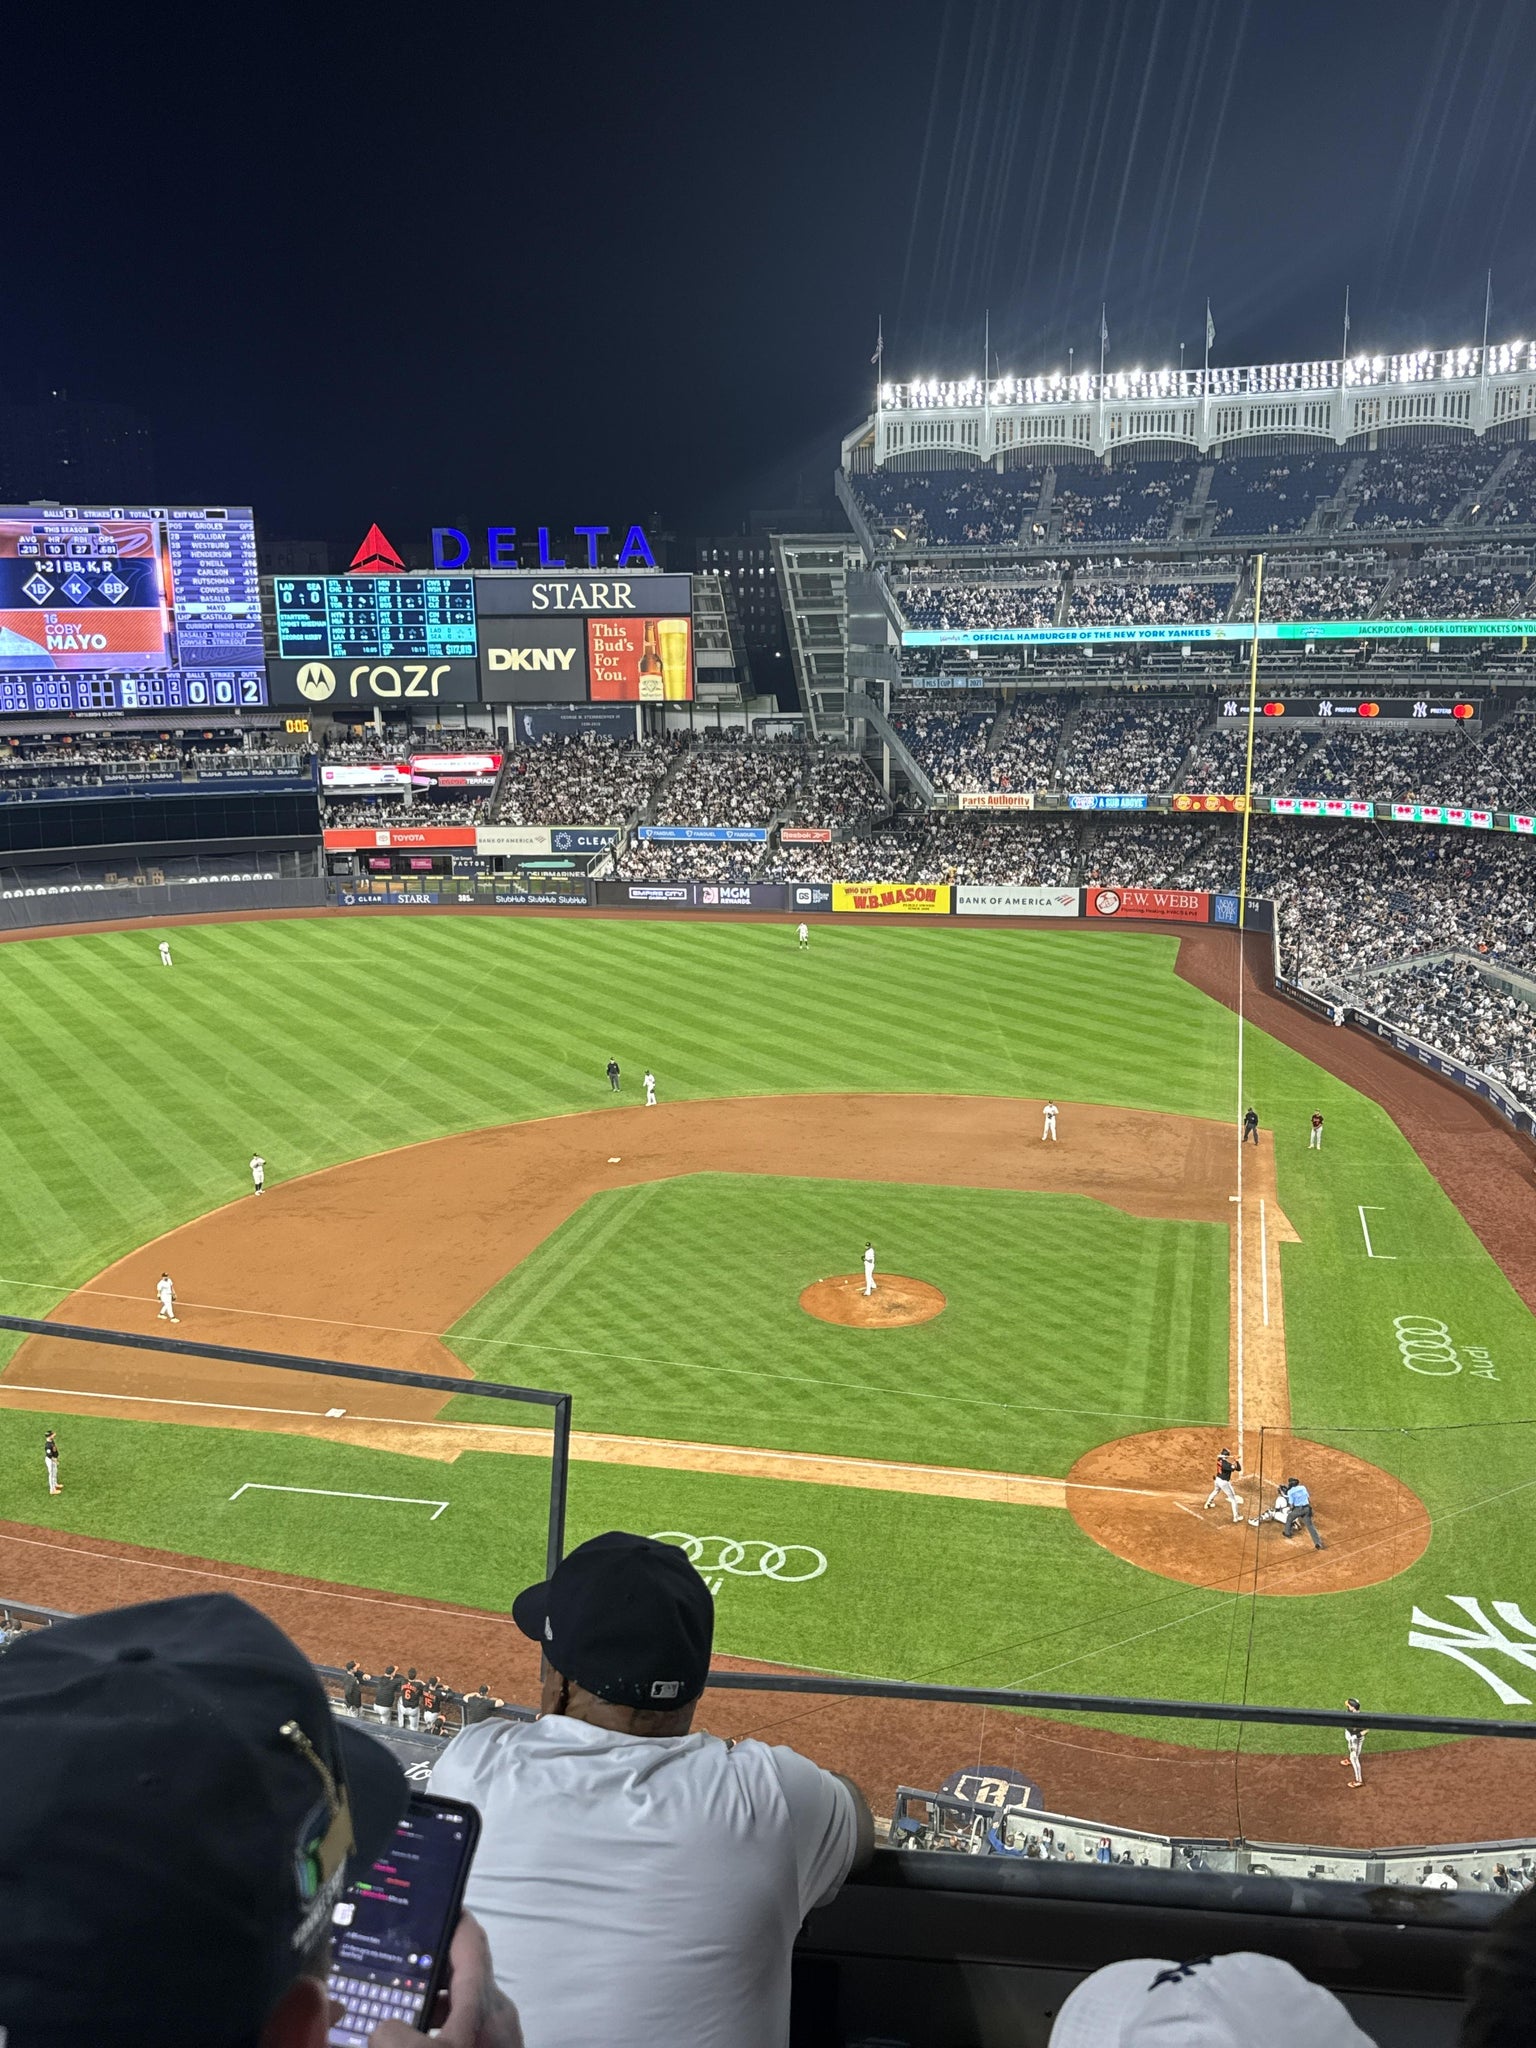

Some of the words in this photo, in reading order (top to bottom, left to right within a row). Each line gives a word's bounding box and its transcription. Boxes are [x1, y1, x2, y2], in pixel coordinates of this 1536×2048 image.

[50, 546, 61, 554] 10
[75, 546, 87, 554] 27
[431, 525, 657, 569] DELTA
[34, 561, 54, 572] 1-2
[64, 561, 85, 574] BB,
[88, 561, 100, 574] K,
[102, 561, 112, 571] R
[32, 584, 47, 594] 1B
[71, 584, 82, 594] K
[104, 584, 123, 593] BB
[279, 583, 295, 591] LAD
[306, 583, 321, 591] SEA
[283, 591, 293, 604] 0
[310, 591, 320, 604] 0
[531, 582, 636, 610] STARR
[43, 614, 58, 624] 16
[45, 624, 82, 635] COBY
[592, 623, 627, 637] This
[1358, 625, 1413, 634] JACKPOT.COM
[1418, 625, 1444, 633] ORDER
[1445, 625, 1478, 633] LOTTERY
[1479, 624, 1510, 633] TICKETS
[1511, 624, 1523, 633] ON
[972, 633, 1015, 641] OFFICIAL
[1017, 632, 1077, 640] HAMBURGER
[1093, 631, 1112, 639] THE
[1138, 630, 1166, 638] YORK
[1167, 629, 1211, 637] YANKEES
[46, 634, 107, 650] MAYO
[594, 638, 634, 652] Bud's
[488, 648, 576, 671] DKNY
[594, 653, 619, 667] For
[594, 668, 627, 681] You.
[350, 665, 451, 697] razr
[4, 686, 11, 695] 0
[17, 685, 24, 694] 3
[36, 685, 43, 694] 0
[48, 685, 55, 693] 0
[80, 684, 87, 692] 0
[140, 682, 147, 691] 6
[171, 682, 178, 691] 2
[190, 681, 206, 703] 0
[216, 681, 232, 702] 0
[243, 680, 259, 702] 2
[6, 700, 13, 709] 0
[18, 699, 26, 708] 4
[37, 699, 44, 708] 0
[50, 699, 57, 707] 0
[285, 719, 309, 733] 0:06
[466, 777, 496, 785] TERRACE
[962, 796, 986, 805] Parts
[987, 795, 1030, 805] Authority
[1099, 797, 1105, 808] A
[1105, 797, 1120, 807] SUB
[1120, 797, 1146, 807] ABOVE
[392, 834, 425, 842] TOYOTA
[783, 831, 812, 839] Reebok
[577, 836, 615, 846] CLEAR
[720, 887, 750, 898] MGM
[844, 887, 859, 895] WHO
[860, 886, 872, 894] BUT
[397, 892, 431, 904] STARR
[495, 895, 526, 904] StubHub
[527, 895, 557, 904] StubHub
[558, 896, 587, 905] StubHub
[959, 896, 988, 906] BANK
[989, 897, 1003, 906] OF
[1004, 897, 1053, 907] AMERICA
[1122, 892, 1150, 906] F.W.
[1153, 893, 1199, 909] WEBB
[1219, 899, 1234, 907] NEW
[1218, 905, 1237, 915] YORK
[1248, 901, 1260, 909] 314
[1218, 912, 1234, 921] LIFE
[1460, 1345, 1502, 1382] Audi
[404, 1689, 411, 1700] 6
[424, 1697, 433, 1709] 15
